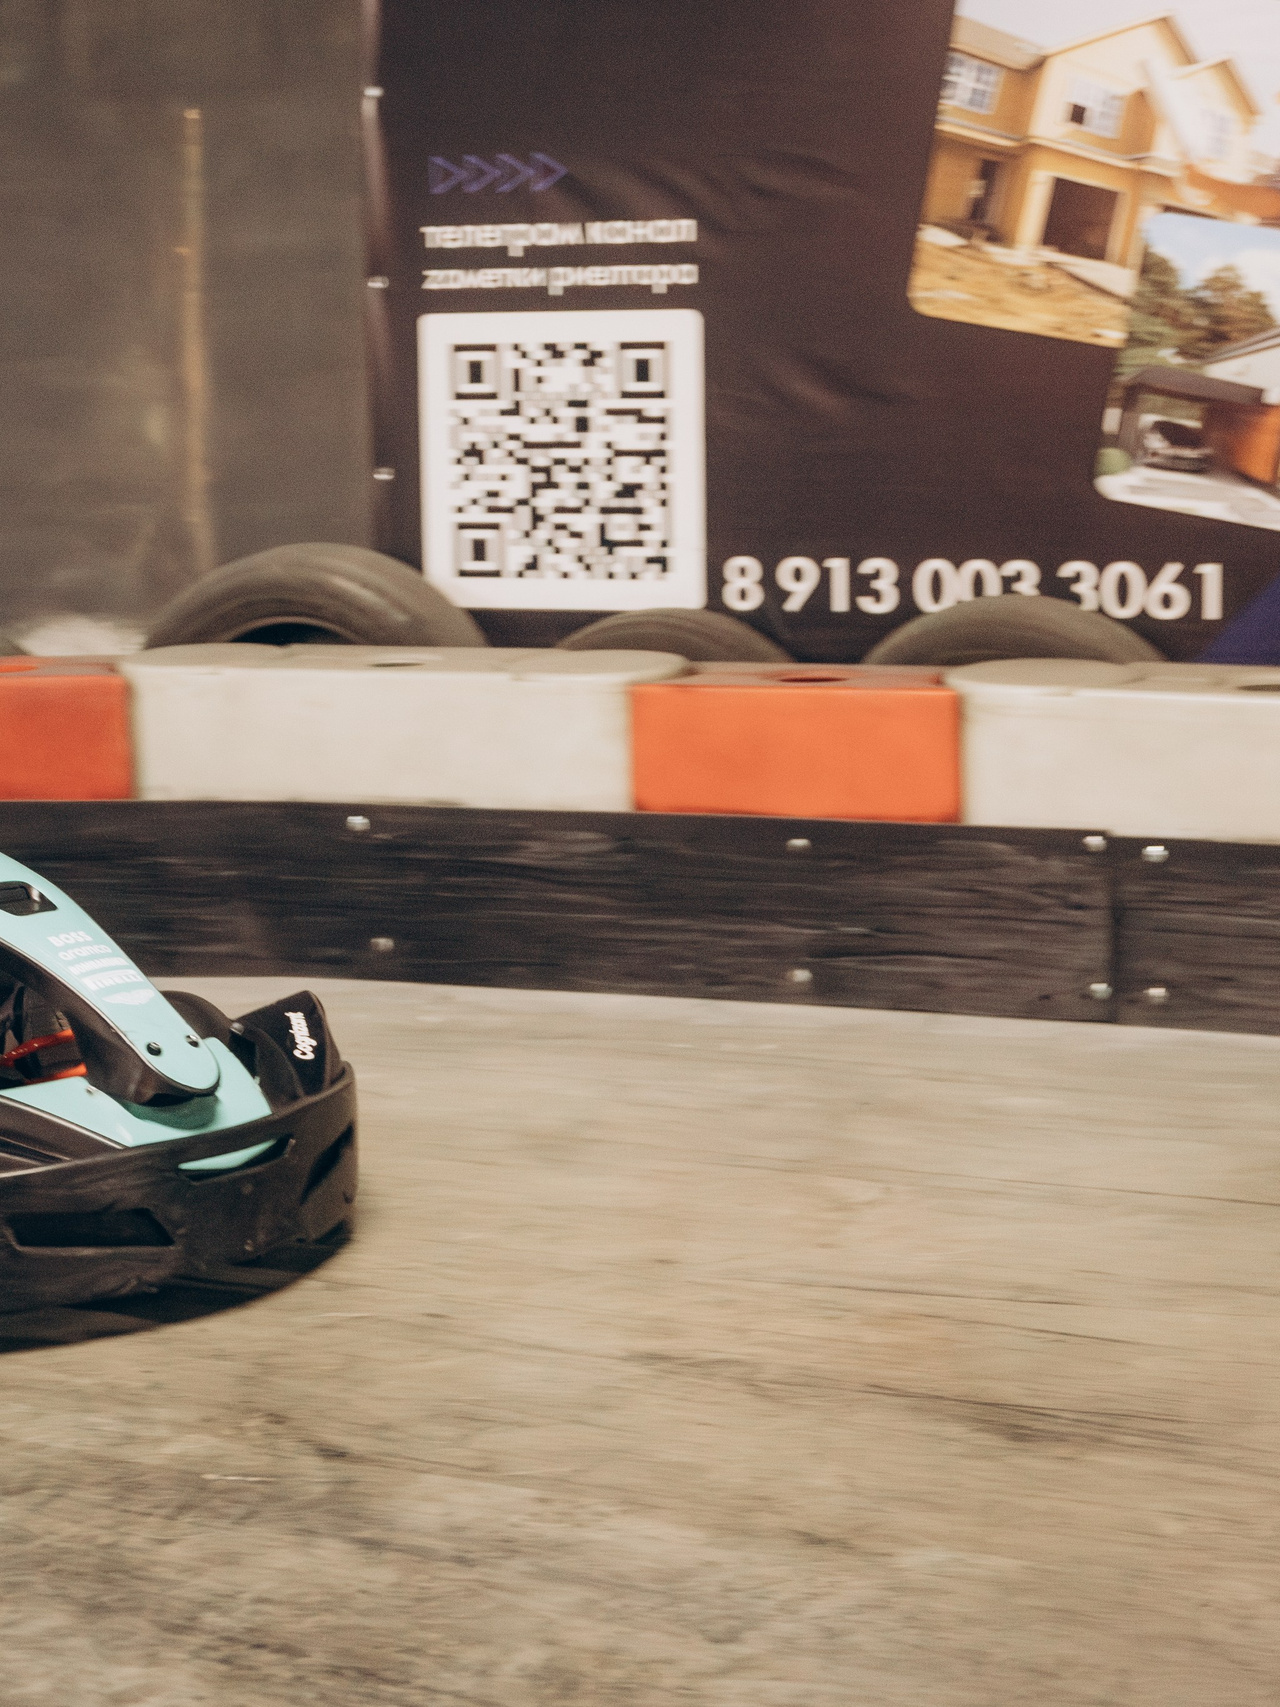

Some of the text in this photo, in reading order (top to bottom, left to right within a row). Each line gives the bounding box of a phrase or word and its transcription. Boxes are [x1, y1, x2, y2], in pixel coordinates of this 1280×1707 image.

[721, 556, 1225, 620] 8 913 003 3061
[47, 930, 94, 947] BOSS
[58, 944, 113, 961] aramco
